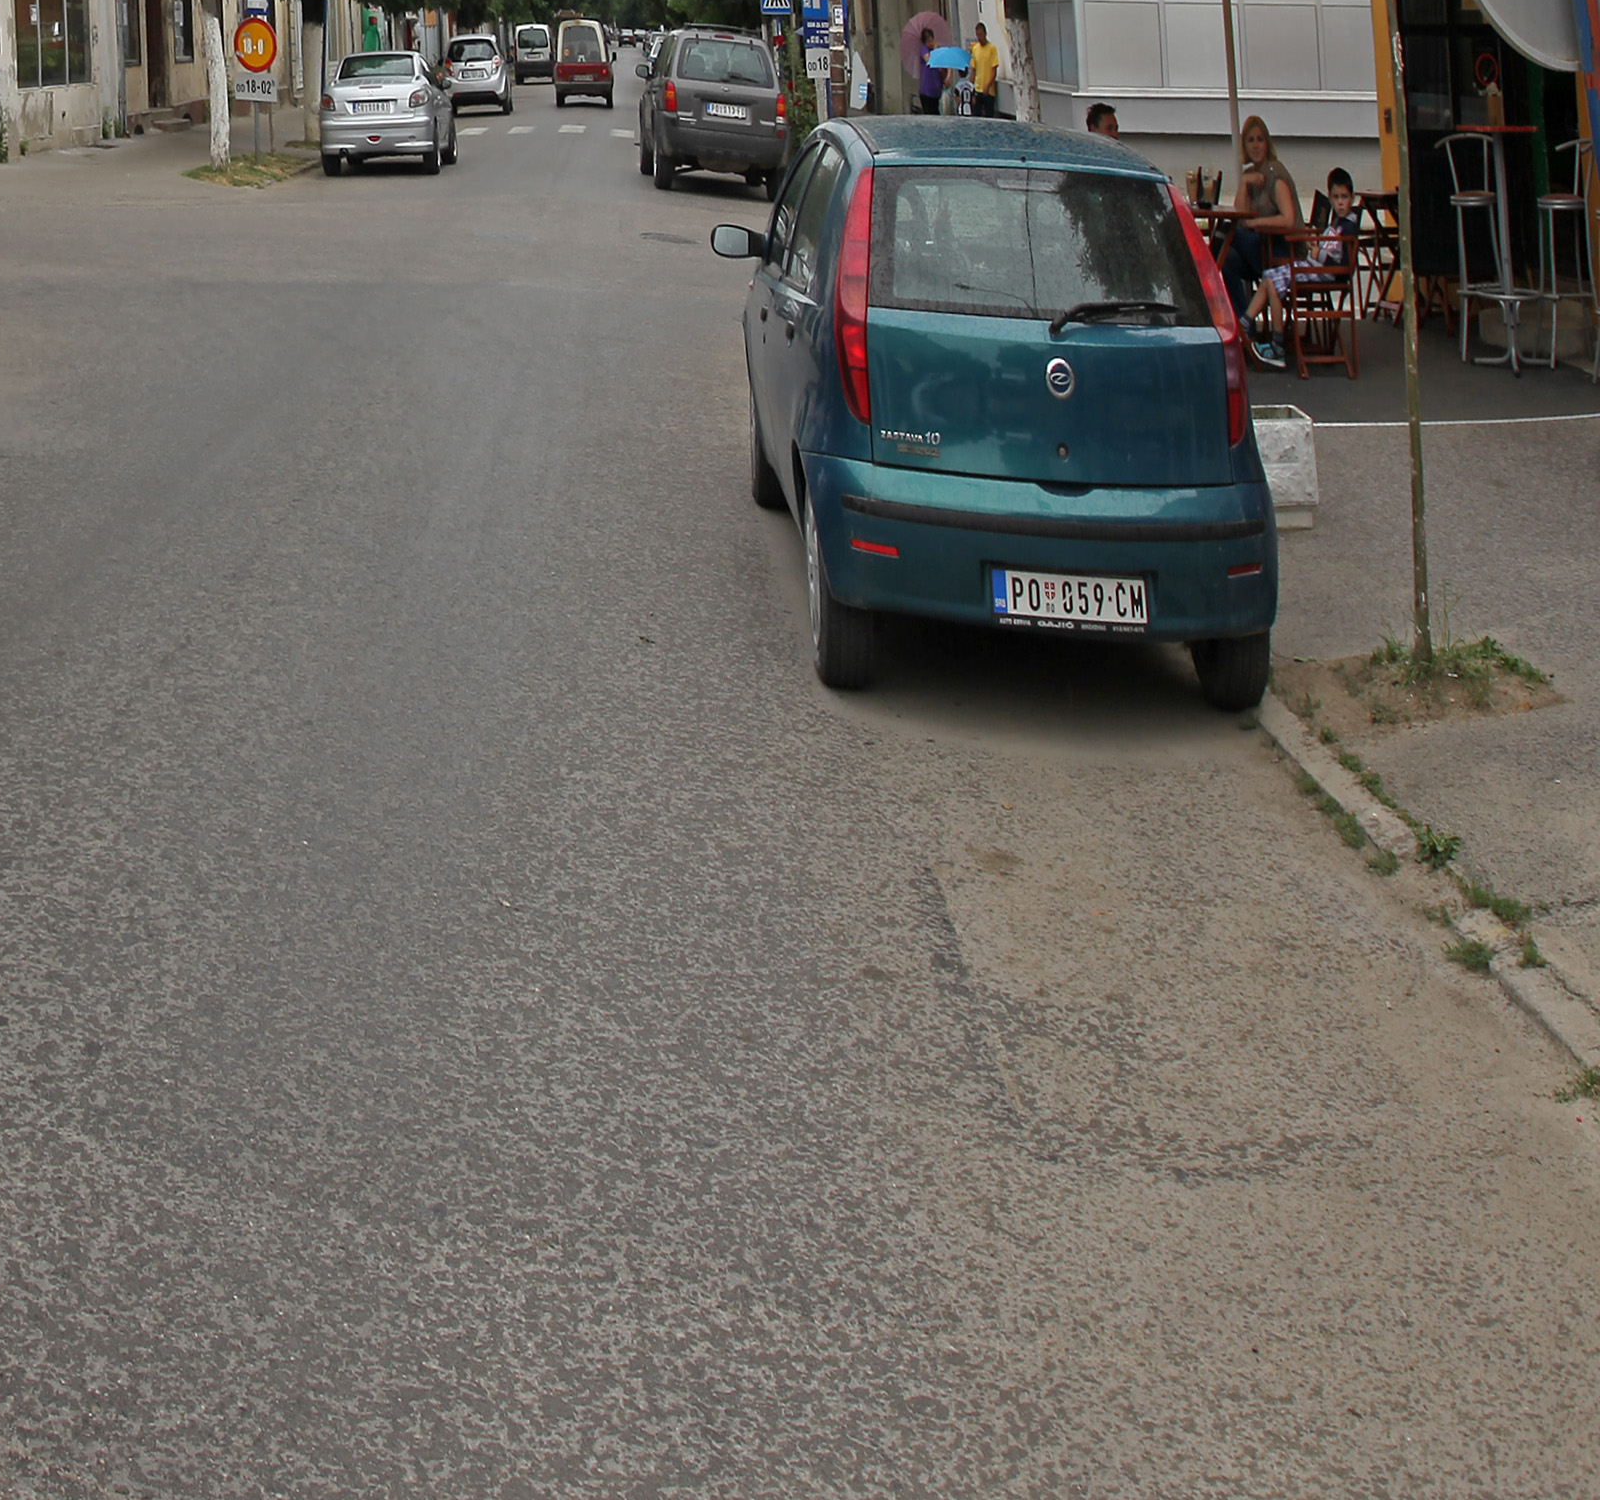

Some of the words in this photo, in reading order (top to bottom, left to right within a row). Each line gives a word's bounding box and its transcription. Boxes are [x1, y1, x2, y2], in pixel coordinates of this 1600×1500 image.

[817, 56, 829, 69] 18
[880, 429, 924, 443] ZASTAVA
[925, 431, 941, 445] 10
[1011, 576, 1041, 612] PO
